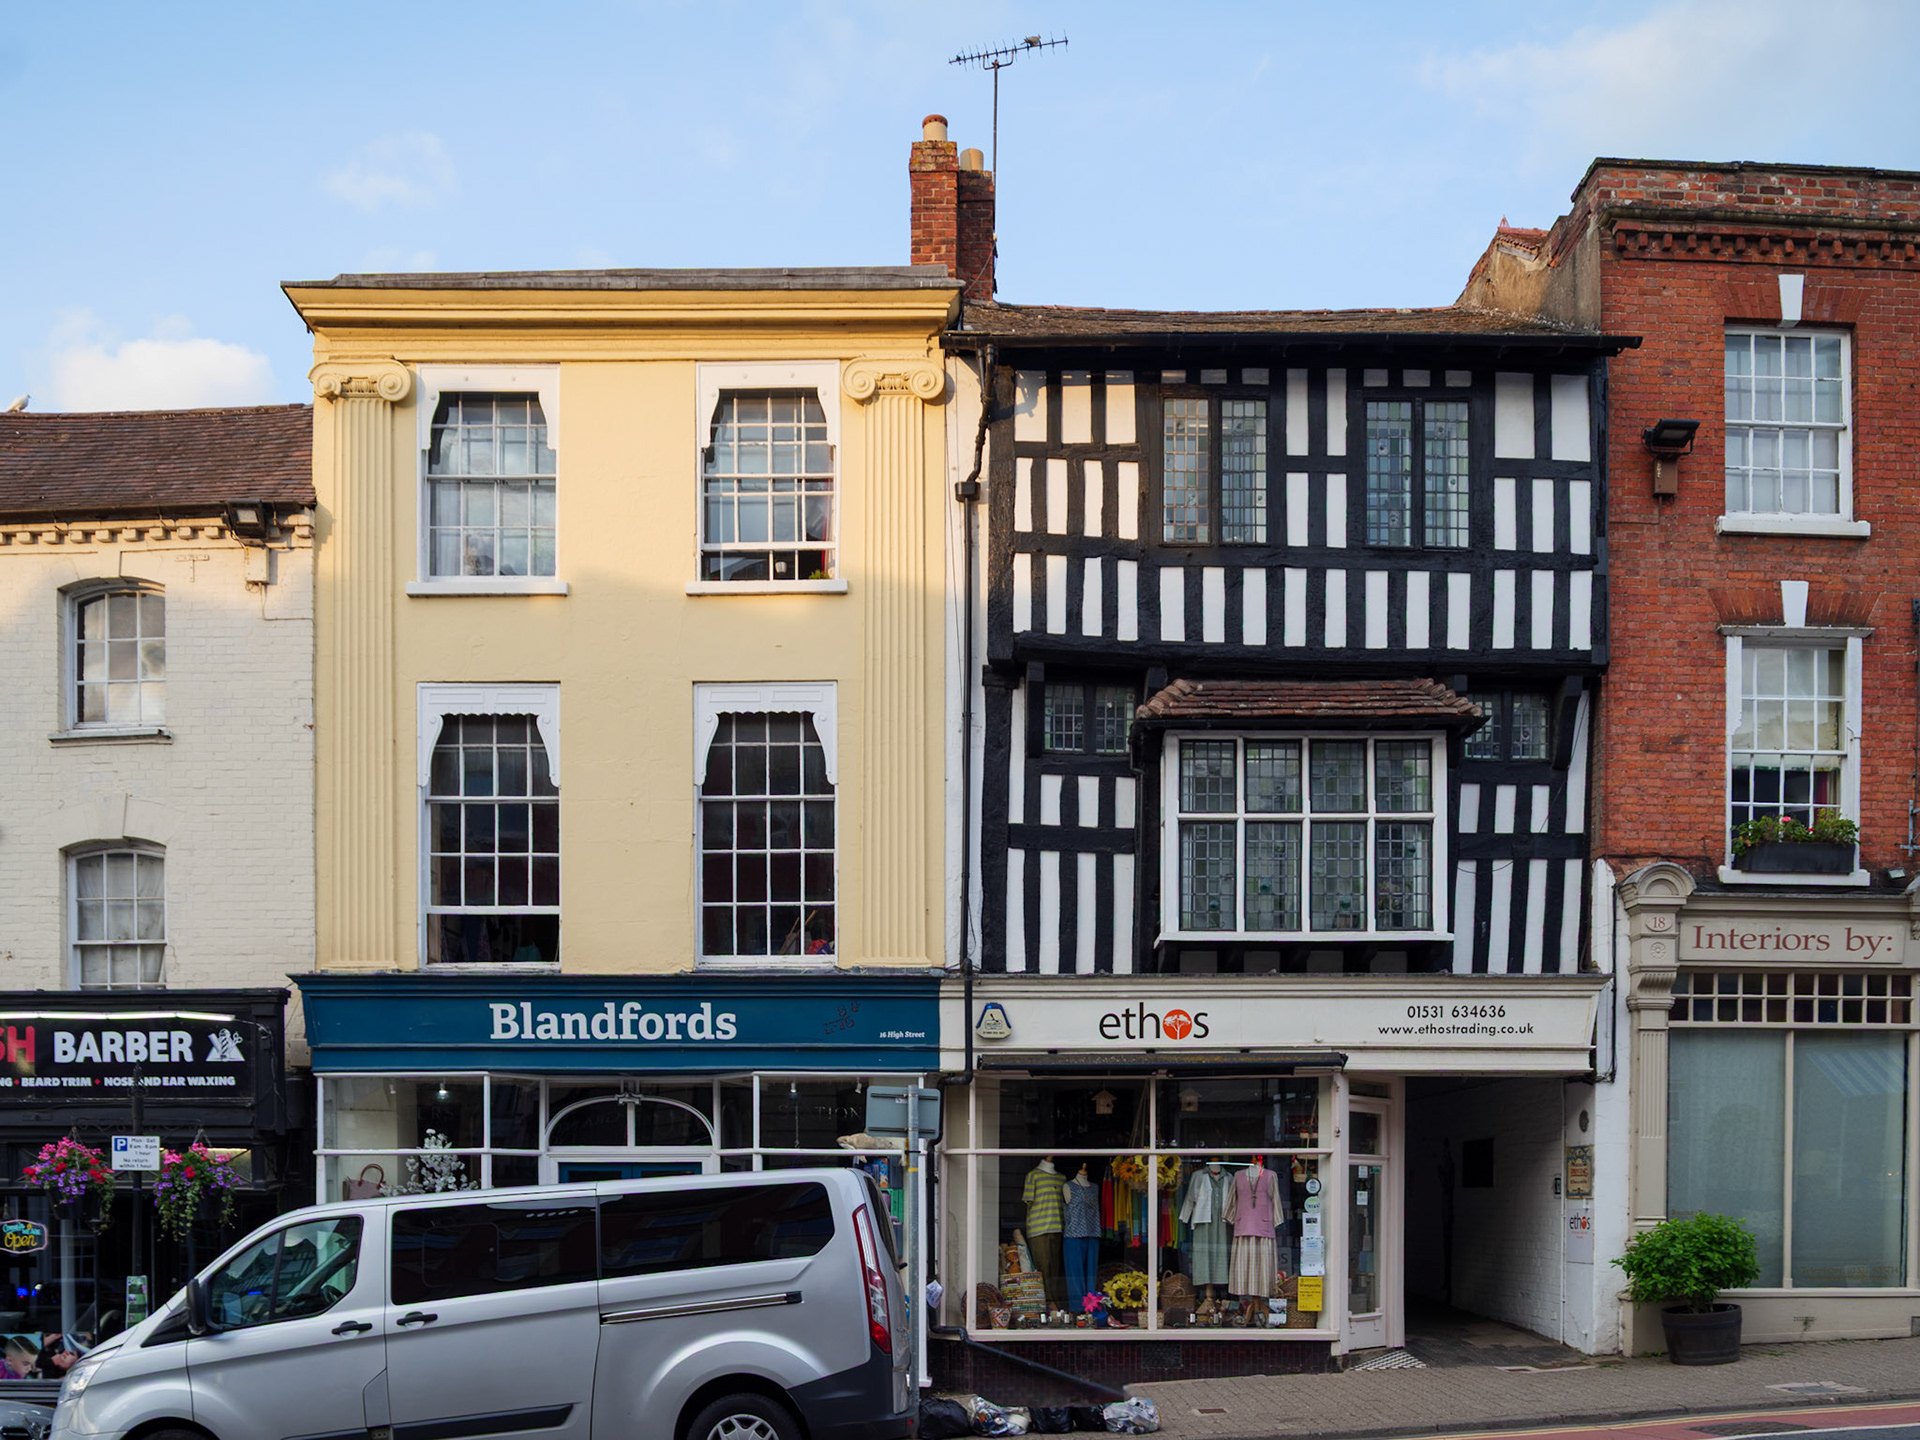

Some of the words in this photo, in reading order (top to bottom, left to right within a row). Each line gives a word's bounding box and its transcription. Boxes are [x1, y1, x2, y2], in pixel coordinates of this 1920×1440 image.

[1653, 917, 1666, 929] 18
[1693, 925, 1830, 952] Interiors
[1844, 926, 1893, 960] by:
[489, 1001, 738, 1041] Blandfords
[1099, 1001, 1210, 1040] ethos
[1407, 1005, 1444, 1019] 01531
[1451, 1005, 1506, 1018] 634636
[887, 1030, 904, 1040] High
[905, 1030, 926, 1039] Street
[1378, 1022, 1534, 1037] www.ethostrading.co.uk
[0, 1025, 36, 1063] H
[54, 1031, 193, 1063] BARBER
[21, 1076, 61, 1087] BEARD
[61, 1076, 93, 1087] TRIM
[162, 1076, 186, 1087] EAR
[187, 1076, 236, 1087] WAXING
[1569, 1212, 1591, 1230] ethos
[4, 1232, 38, 1251] Open
